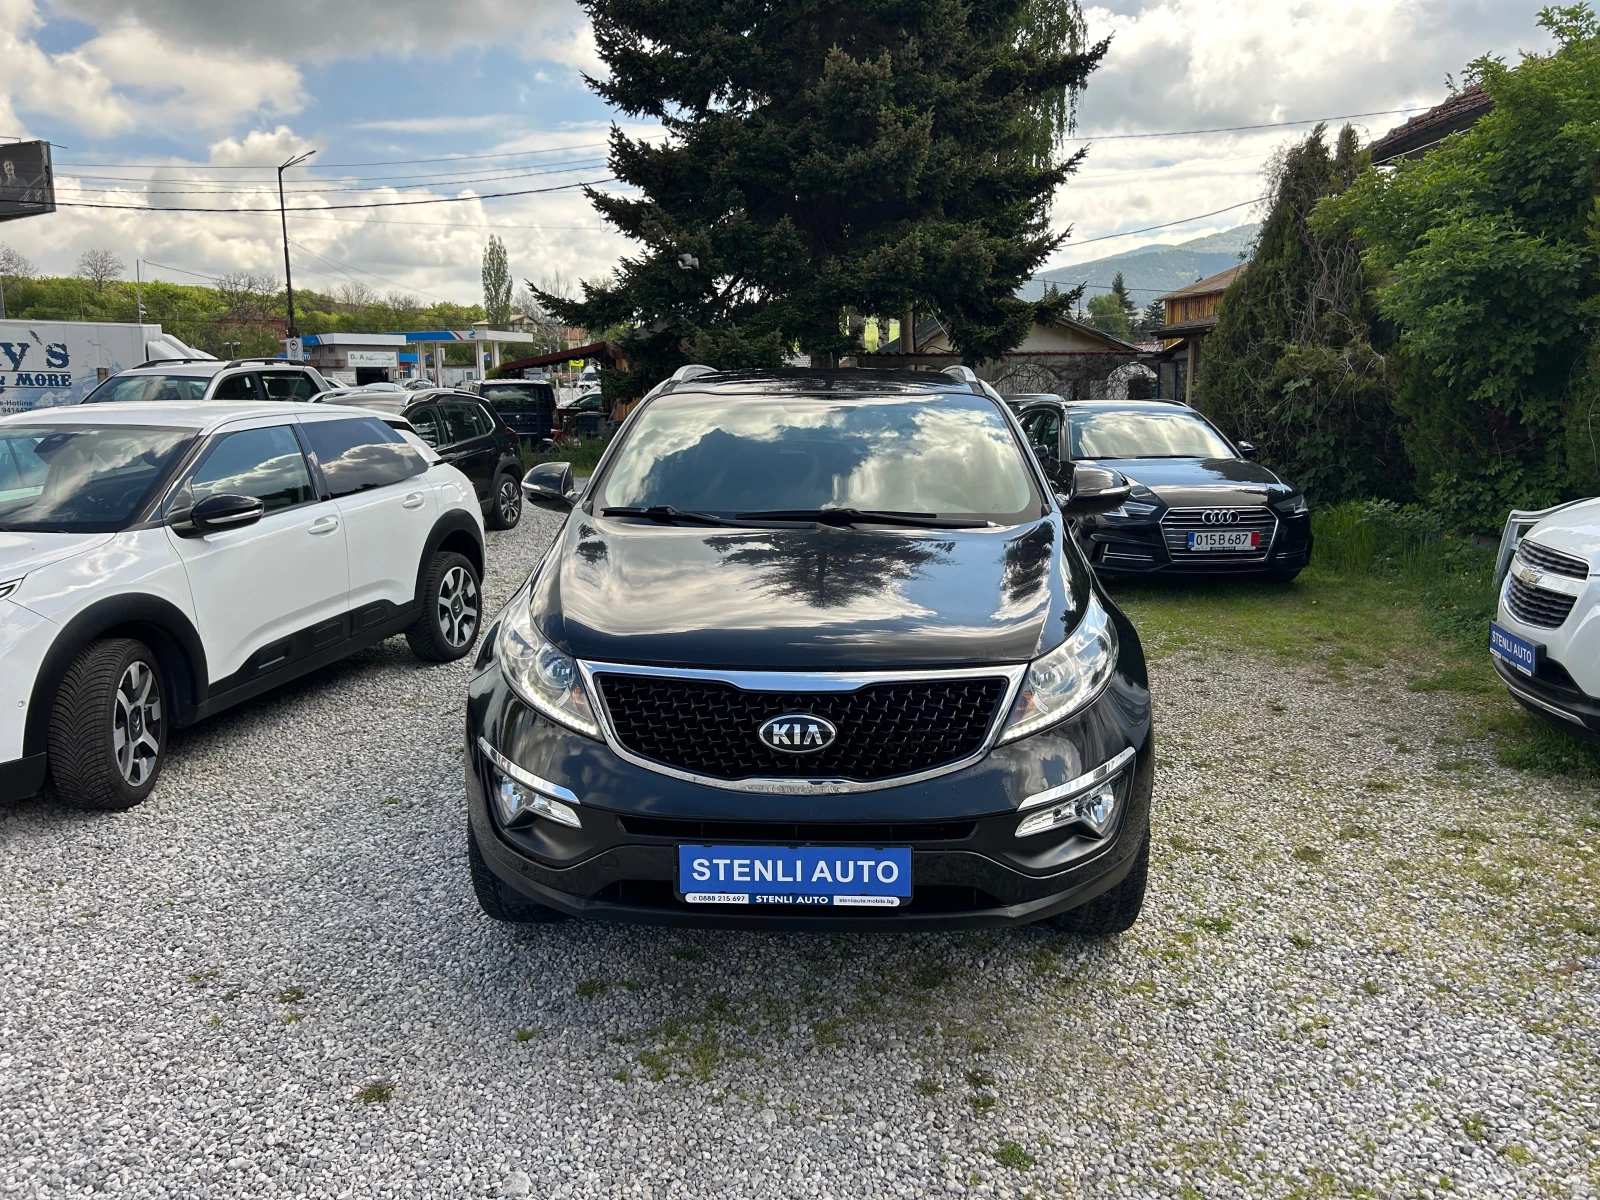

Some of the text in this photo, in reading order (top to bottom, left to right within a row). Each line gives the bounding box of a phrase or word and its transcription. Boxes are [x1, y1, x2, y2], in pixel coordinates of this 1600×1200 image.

[14, 373, 72, 387] MORE
[1492, 630, 1512, 653] STENLI
[1513, 643, 1532, 664] AUTO
[772, 723, 824, 745] KIA
[692, 858, 899, 884] STENLI AUTO
[755, 894, 794, 904] STENLI
[796, 895, 829, 905] AUTO
